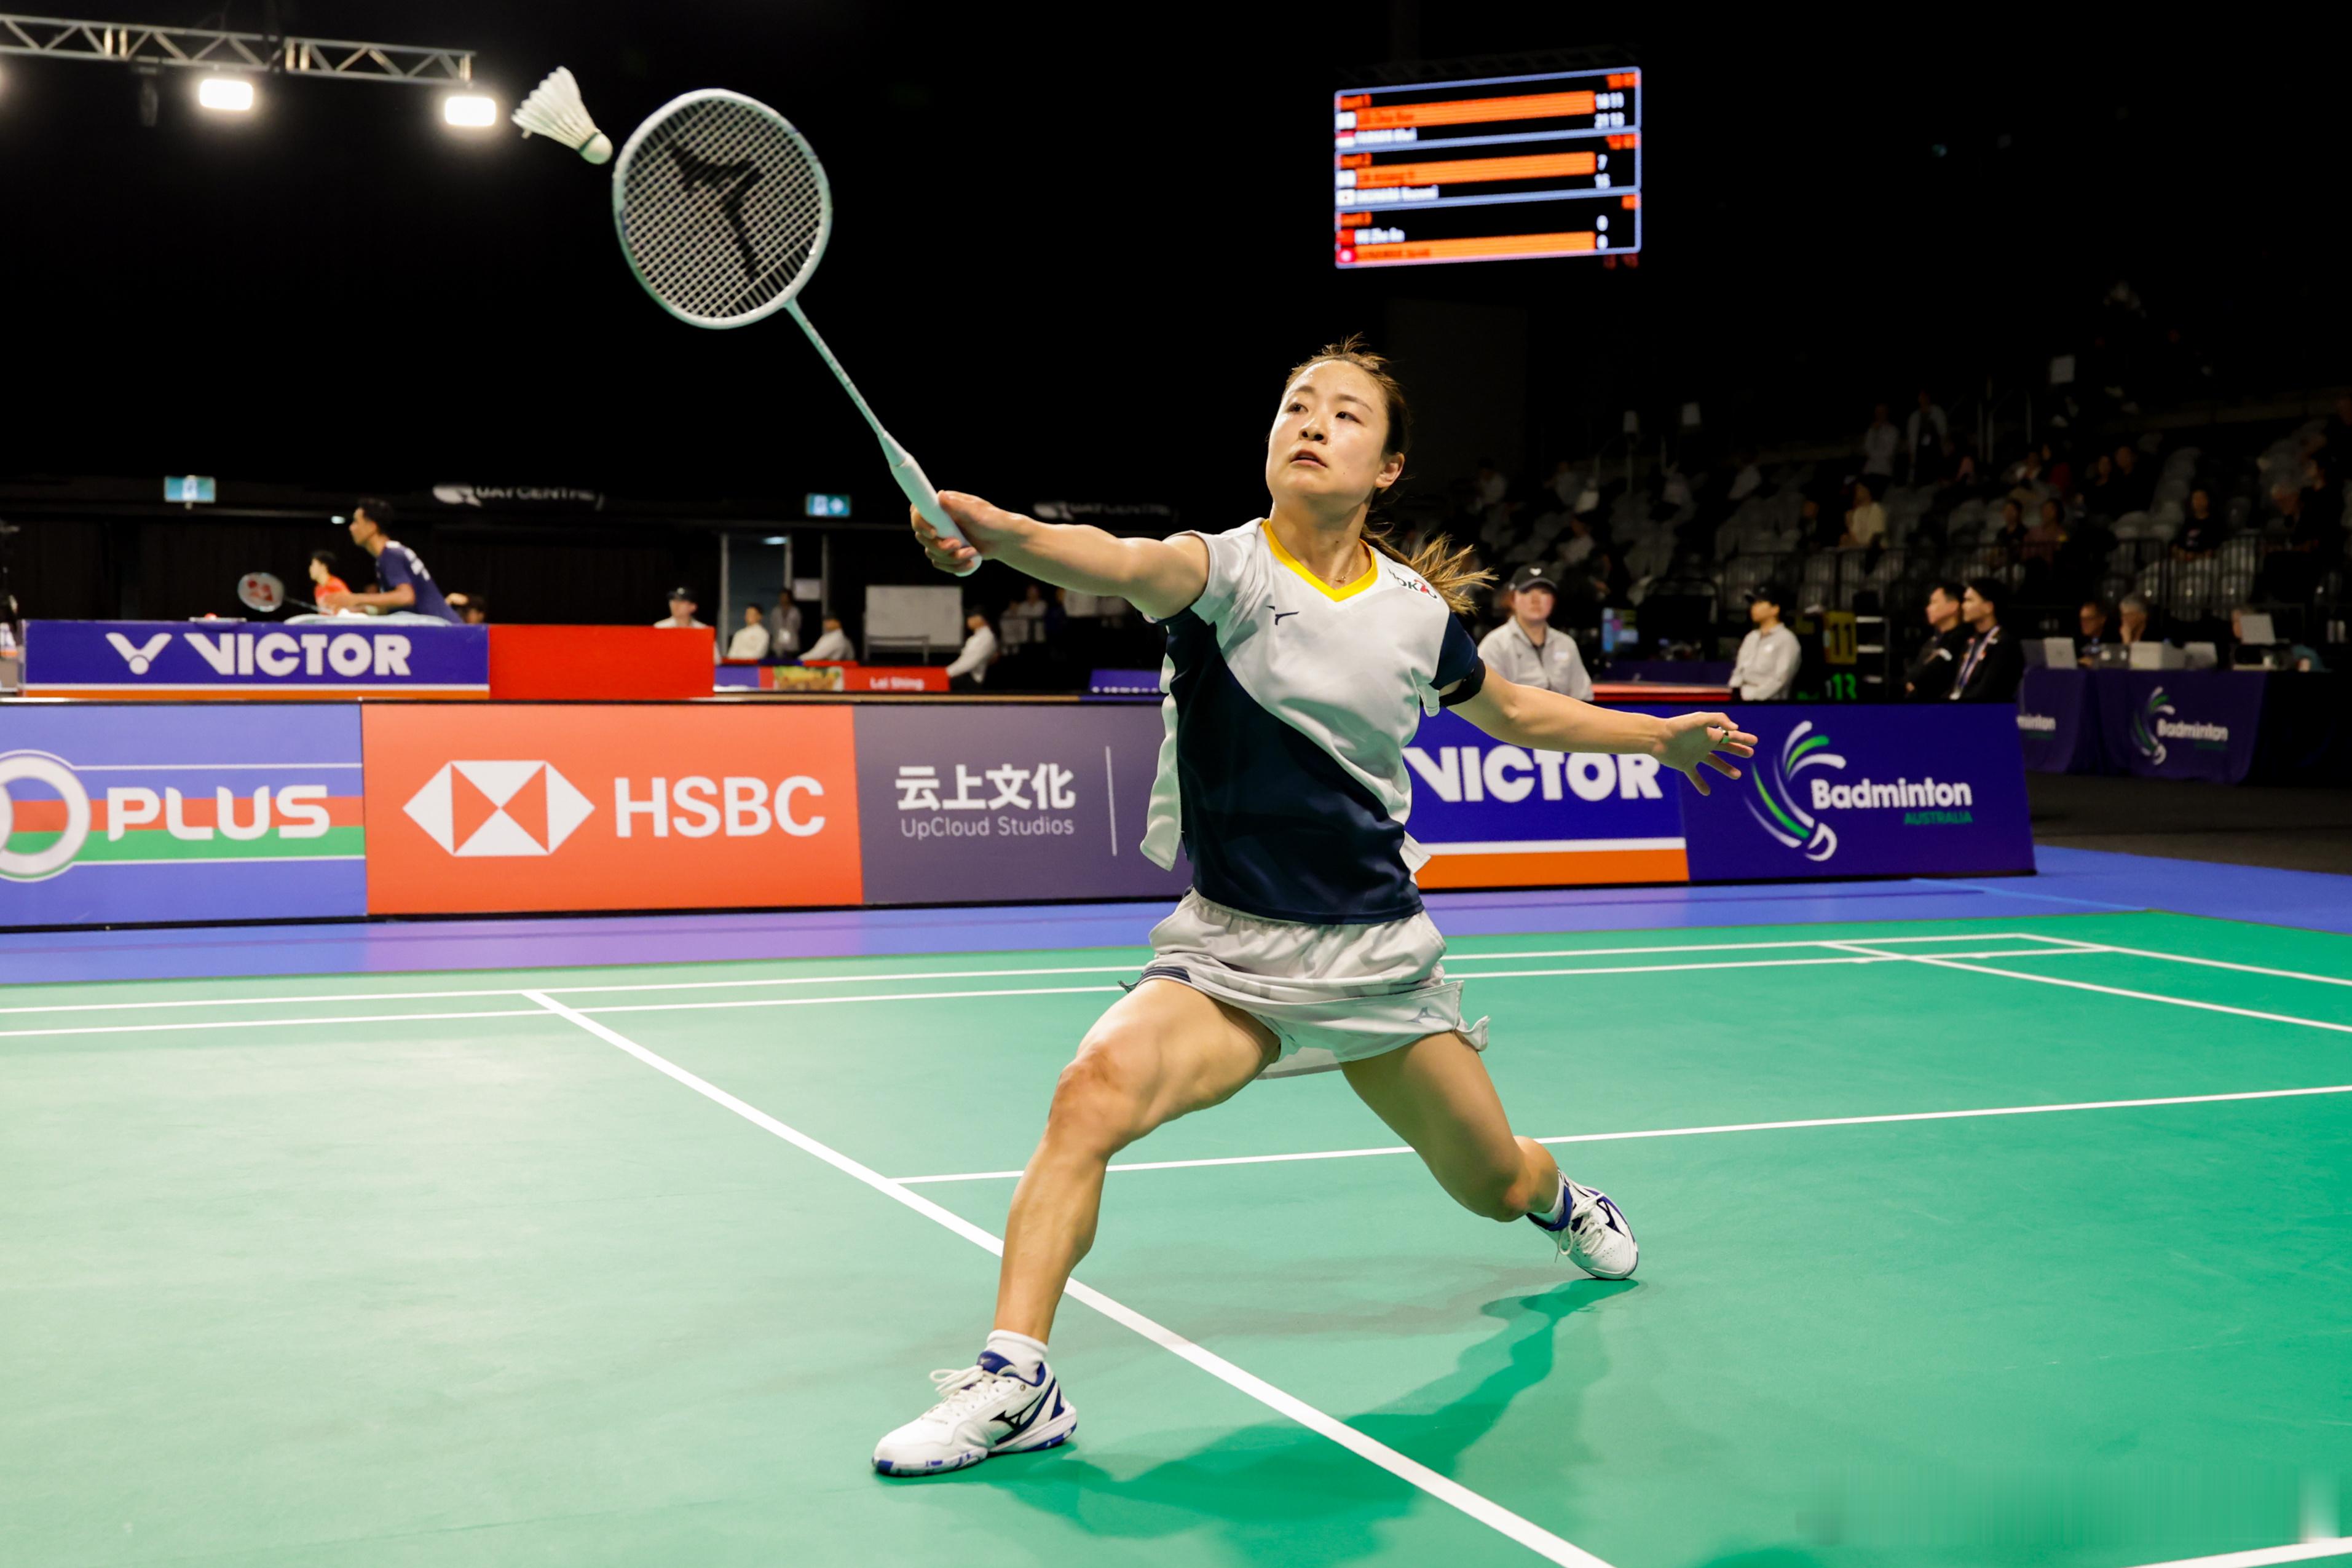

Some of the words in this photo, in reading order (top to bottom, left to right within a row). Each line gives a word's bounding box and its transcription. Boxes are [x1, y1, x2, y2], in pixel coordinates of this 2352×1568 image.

[184, 632, 411, 677] VICTOR
[2016, 714, 2056, 731] minton
[895, 763, 1076, 811] 云上文化
[1400, 744, 1663, 803] VICTOR
[615, 775, 826, 838] HSBC
[1810, 777, 1973, 810] Badminton
[901, 816, 990, 841] UpCloud
[997, 815, 1075, 836] Studios
[1903, 811, 1973, 825] AUSTRALIA
